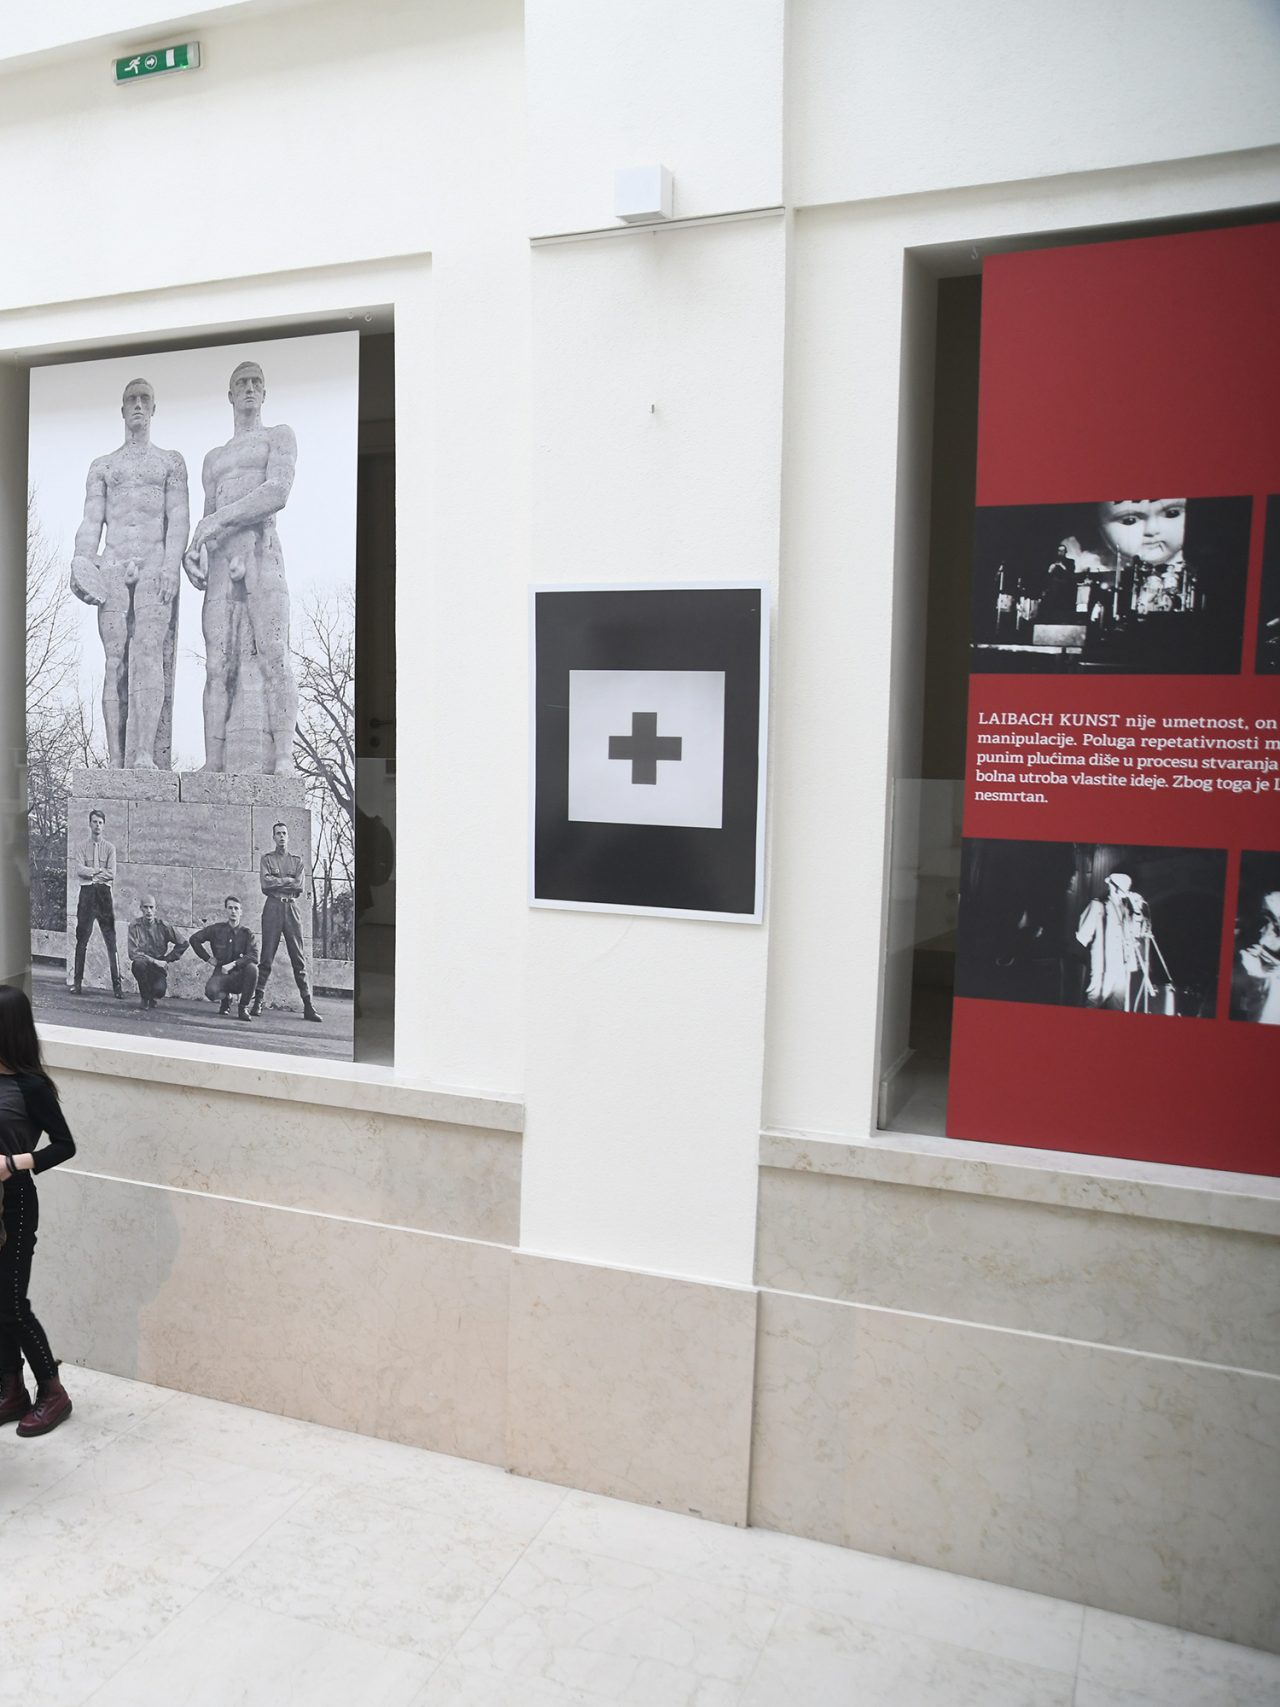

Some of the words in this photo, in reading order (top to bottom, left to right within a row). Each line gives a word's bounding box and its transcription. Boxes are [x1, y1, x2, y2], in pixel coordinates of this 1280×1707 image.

[978, 712, 1054, 726] LAIBACH
[1060, 713, 1121, 727] KUNST
[1125, 714, 1156, 731] nije
[1162, 716, 1249, 731] umetnost,
[1255, 719, 1277, 730] on
[977, 732, 1077, 749] manipulacije.
[1082, 733, 1136, 750] Poluga
[1140, 735, 1259, 751] repetativnosti
[976, 751, 1024, 765] punim
[1027, 751, 1086, 767] plućima
[1088, 753, 1120, 766] diše
[1123, 757, 1133, 767] u
[1136, 757, 1199, 770] procesu
[1201, 757, 1278, 774] stvaranja
[976, 769, 1016, 783] bolna
[1019, 771, 1068, 785] utroba
[1071, 772, 1127, 787] vlastite
[1130, 774, 1169, 791] ideje.
[1172, 775, 1213, 792] Zbog
[1216, 777, 1252, 793] toga
[1253, 777, 1270, 794] je
[974, 791, 1048, 803] nesmrtan.
